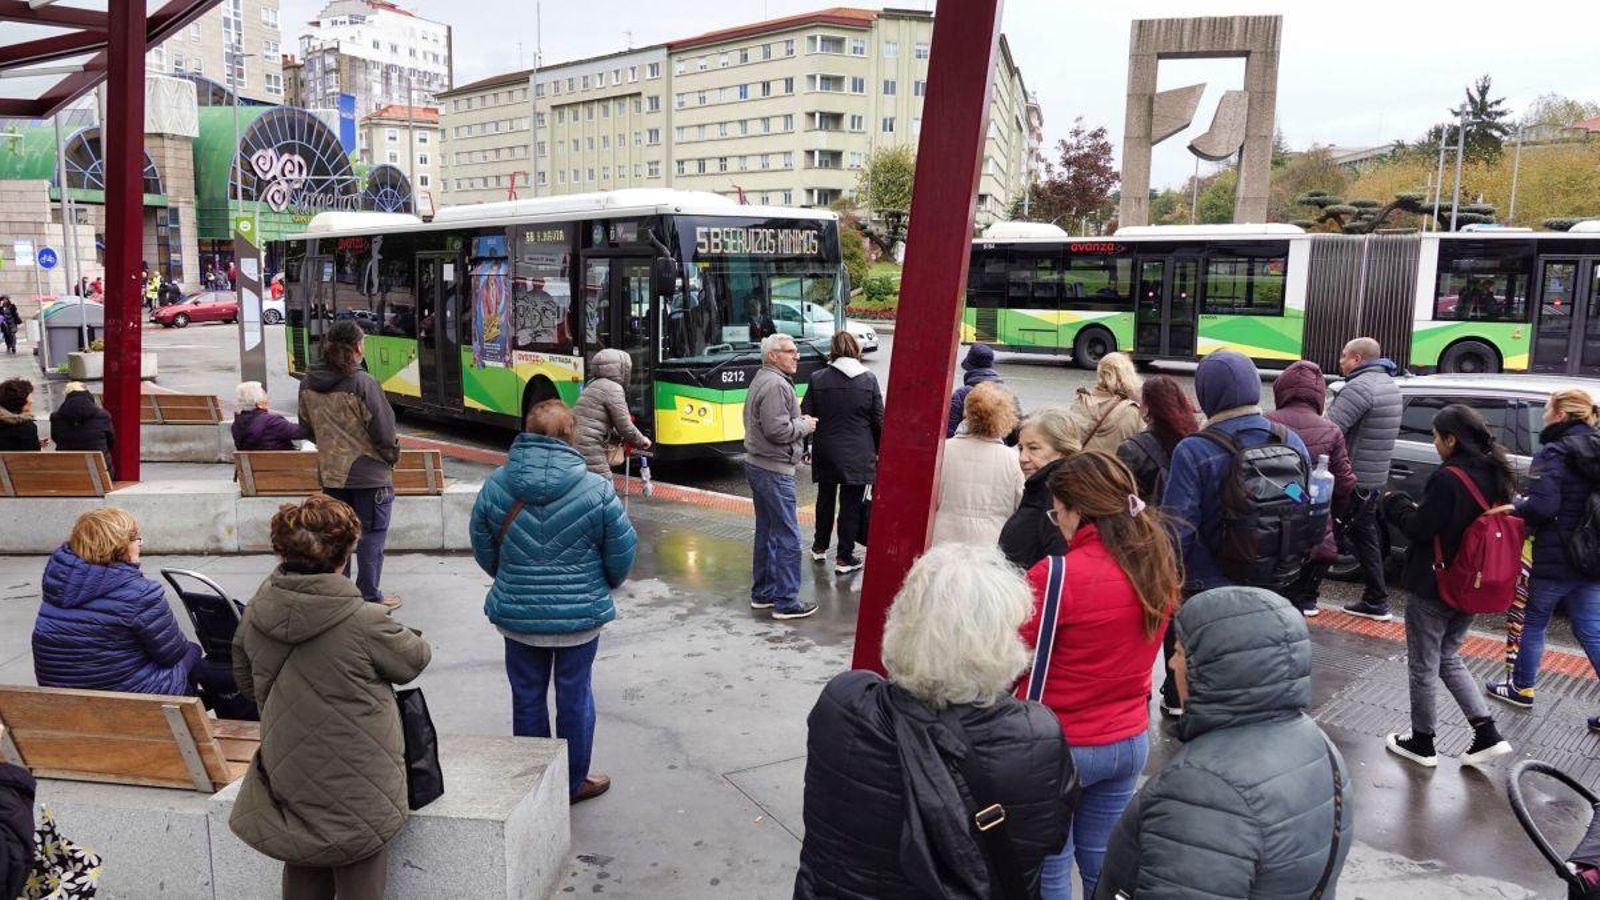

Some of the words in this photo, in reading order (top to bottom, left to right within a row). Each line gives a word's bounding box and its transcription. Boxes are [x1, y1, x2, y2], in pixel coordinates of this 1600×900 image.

[723, 228, 775, 253] SERVIZOS
[1071, 242, 1114, 253] avanza
[721, 370, 745, 383] 6212
